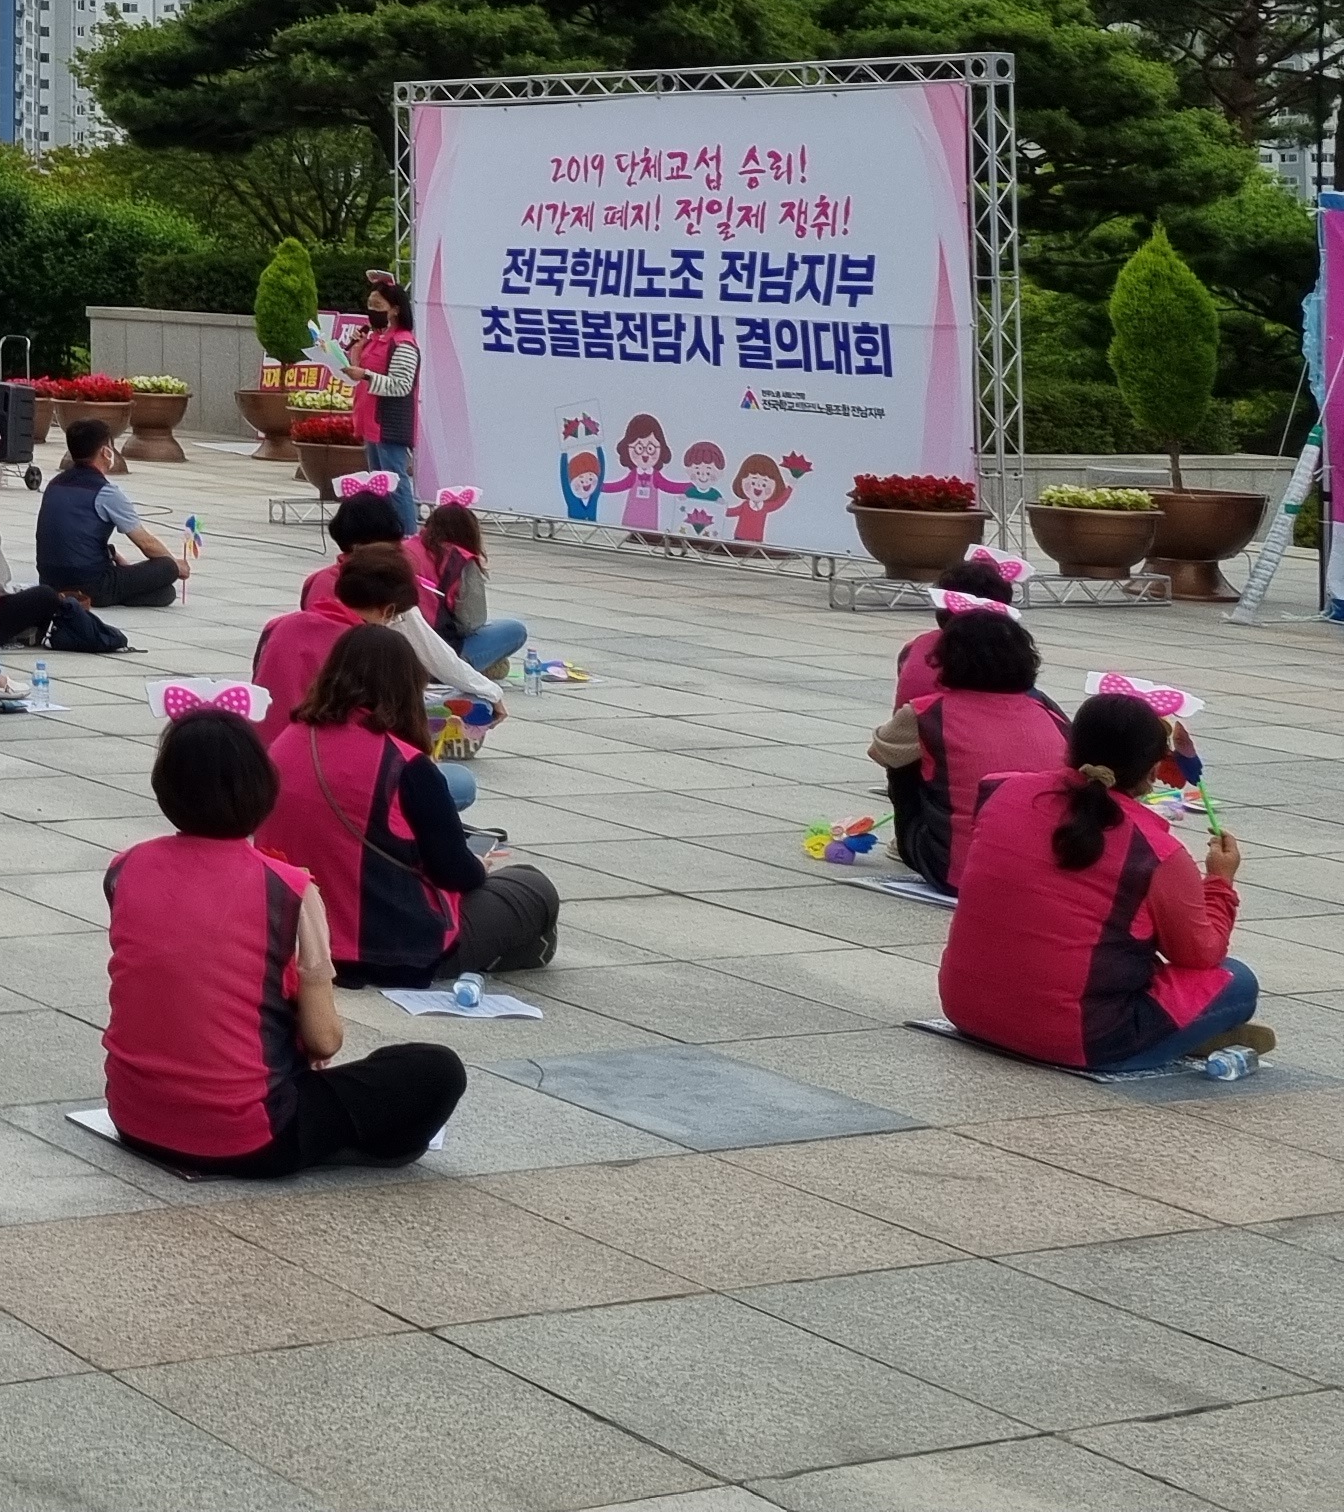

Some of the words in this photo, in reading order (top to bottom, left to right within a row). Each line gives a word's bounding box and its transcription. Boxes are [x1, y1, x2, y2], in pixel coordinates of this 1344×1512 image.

[550, 155, 605, 188] 2019
[615, 143, 722, 191] 단체교섭
[738, 144, 808, 189] 승리!
[521, 198, 595, 235] 시간제
[604, 194, 662, 232] 폐지!
[674, 196, 767, 241] 전일제
[779, 194, 852, 240] 쟁취!
[501, 247, 705, 299] 전국학비노조
[718, 250, 876, 307] 전남지부
[480, 305, 724, 366] 초등돌봄전담사
[736, 316, 893, 377] 결의대회
